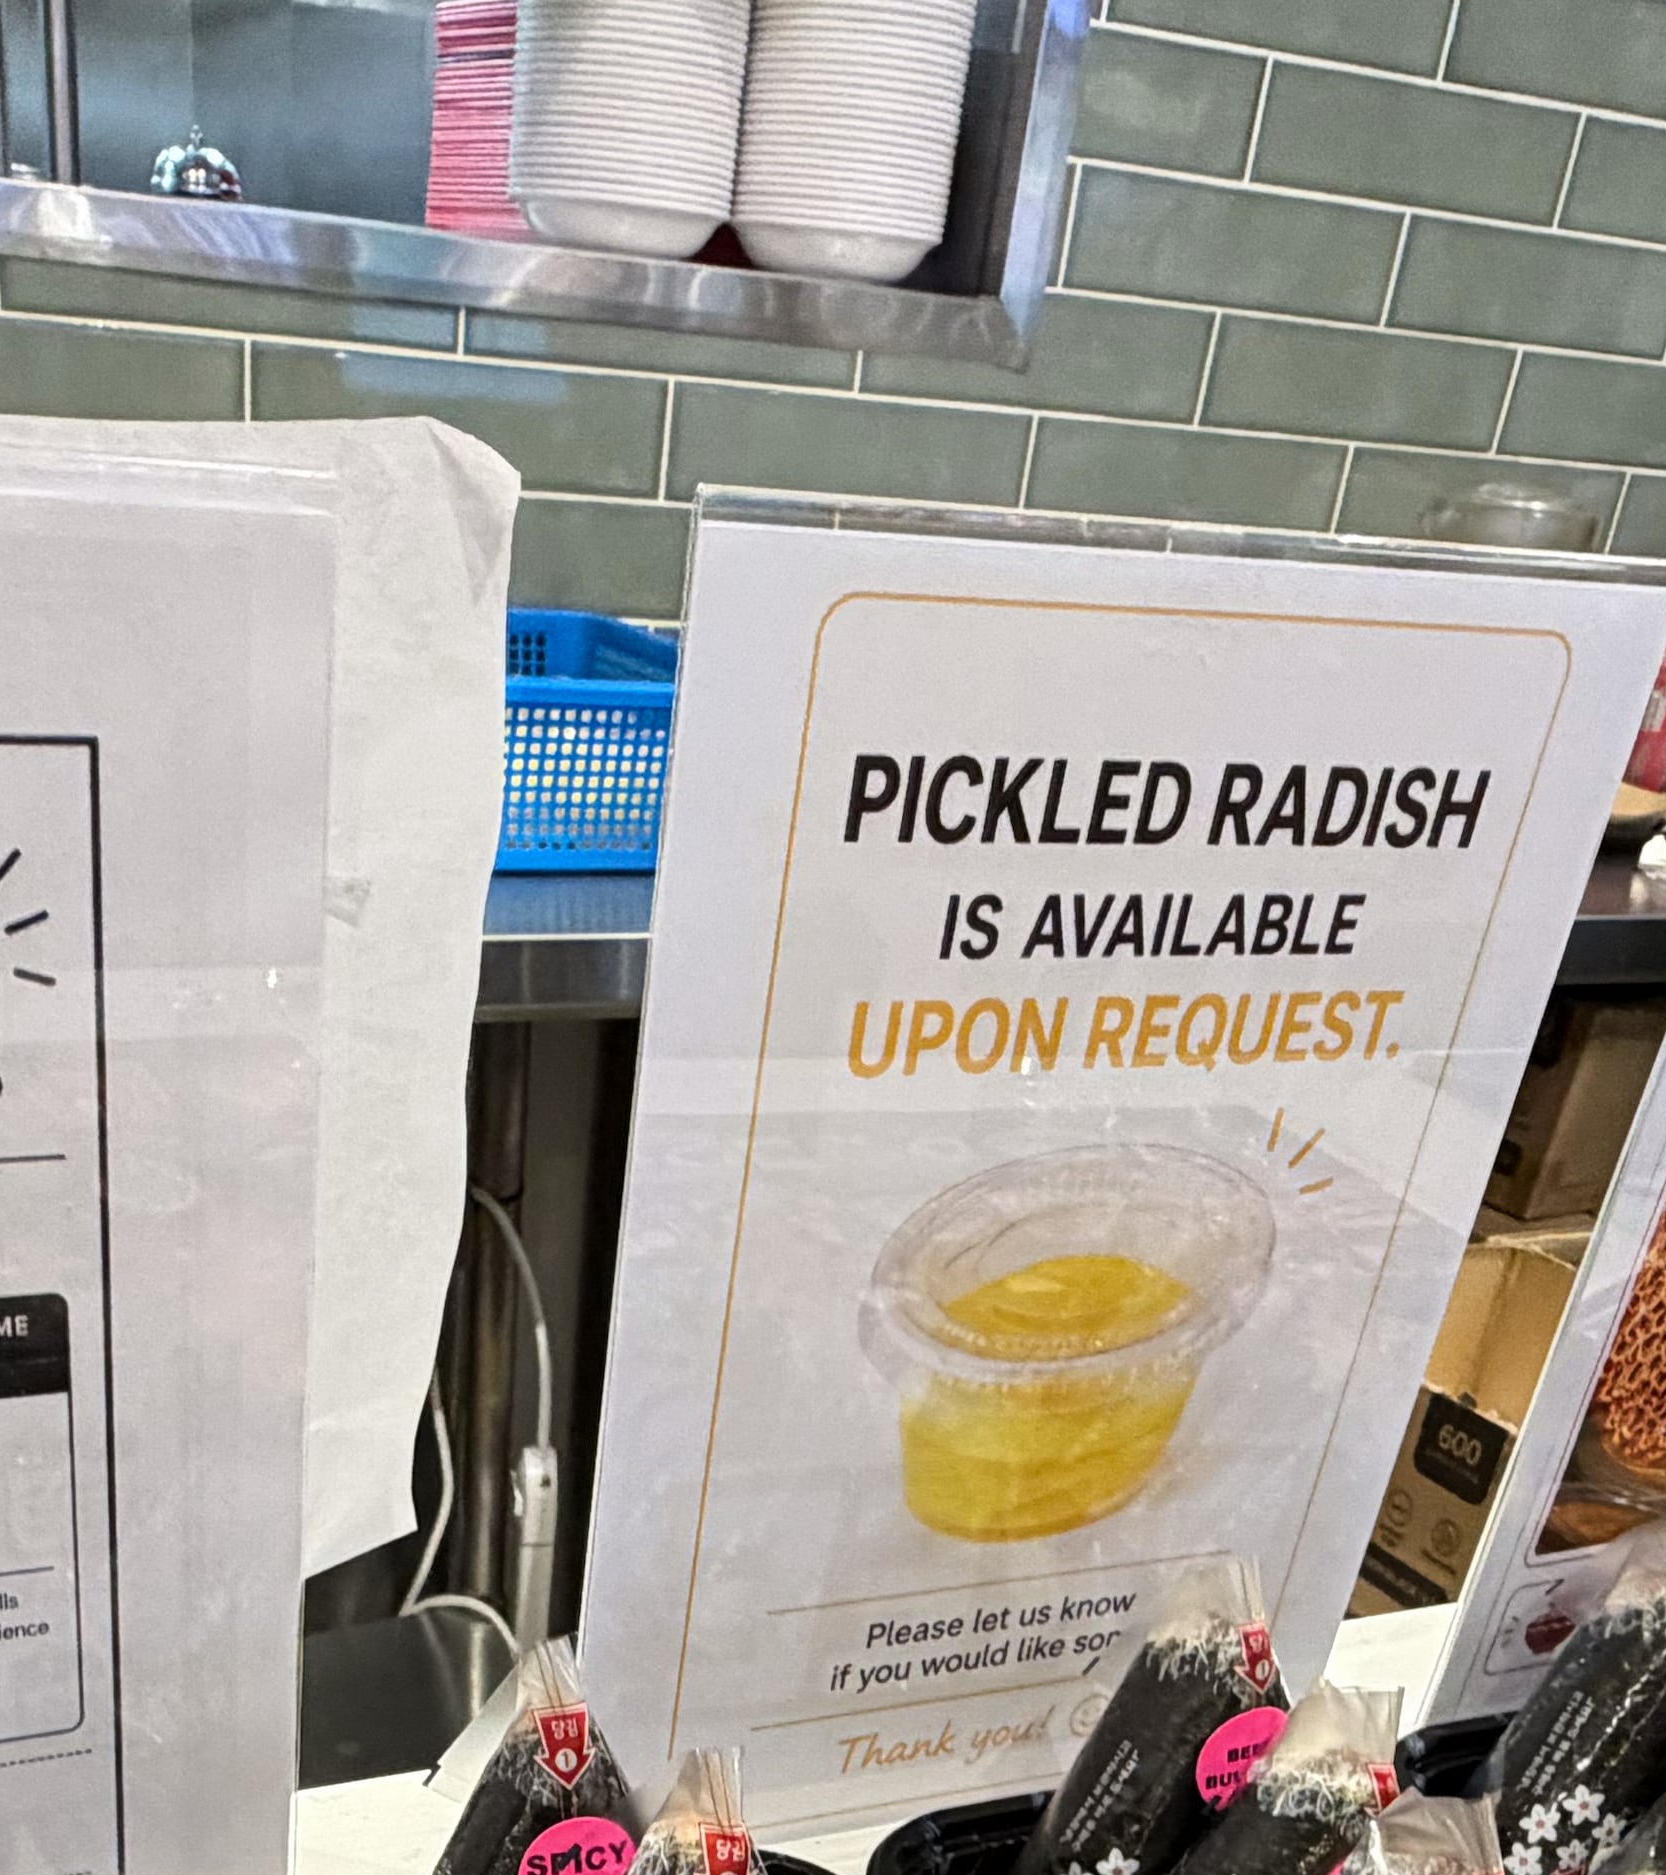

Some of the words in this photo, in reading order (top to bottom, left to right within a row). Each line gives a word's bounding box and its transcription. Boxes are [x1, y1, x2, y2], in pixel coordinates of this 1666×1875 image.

[843, 753, 1194, 847] PICKLED
[1206, 762, 1492, 850] RADISH
[938, 892, 1003, 961] IS
[1020, 892, 1367, 960] AVAILABLE
[846, 993, 1069, 1079] UPON
[1082, 988, 1405, 1073] REQUEST.
[1437, 1423, 1483, 1467] 600
[864, 1614, 964, 1650] Please
[971, 1606, 1013, 1637] let
[1018, 1603, 1051, 1629] us
[1059, 1592, 1137, 1623] know
[829, 1663, 851, 1693] if
[856, 1656, 915, 1696] you
[920, 1640, 1011, 1677] would
[1015, 1632, 1065, 1666] like
[838, 1724, 956, 1776] Thank
[961, 1706, 1051, 1754] you!
